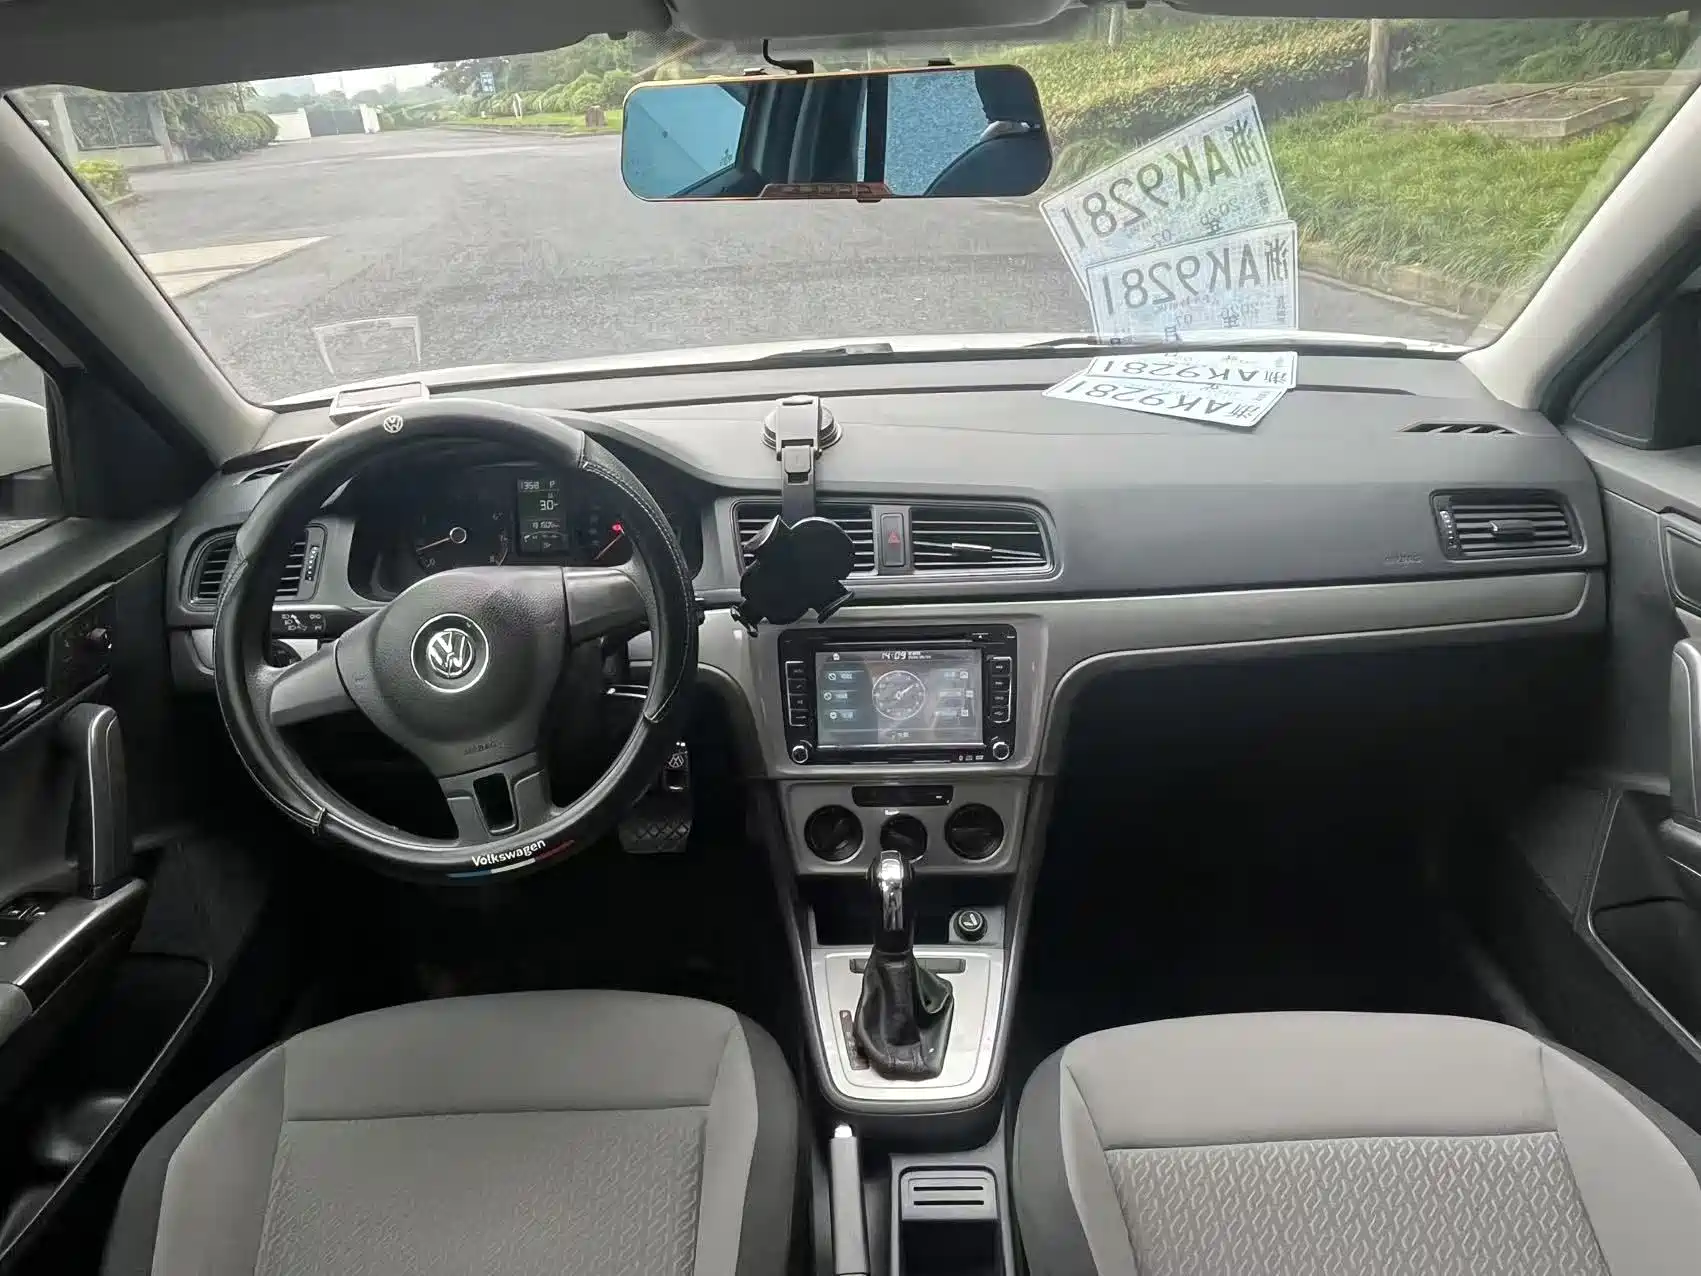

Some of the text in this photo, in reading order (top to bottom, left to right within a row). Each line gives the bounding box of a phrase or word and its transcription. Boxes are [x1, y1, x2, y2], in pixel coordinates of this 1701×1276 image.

[1104, 361, 1287, 384] 浙AK9281
[1065, 380, 1259, 419] 浙AK9281
[471, 838, 547, 867] Volkswagen
